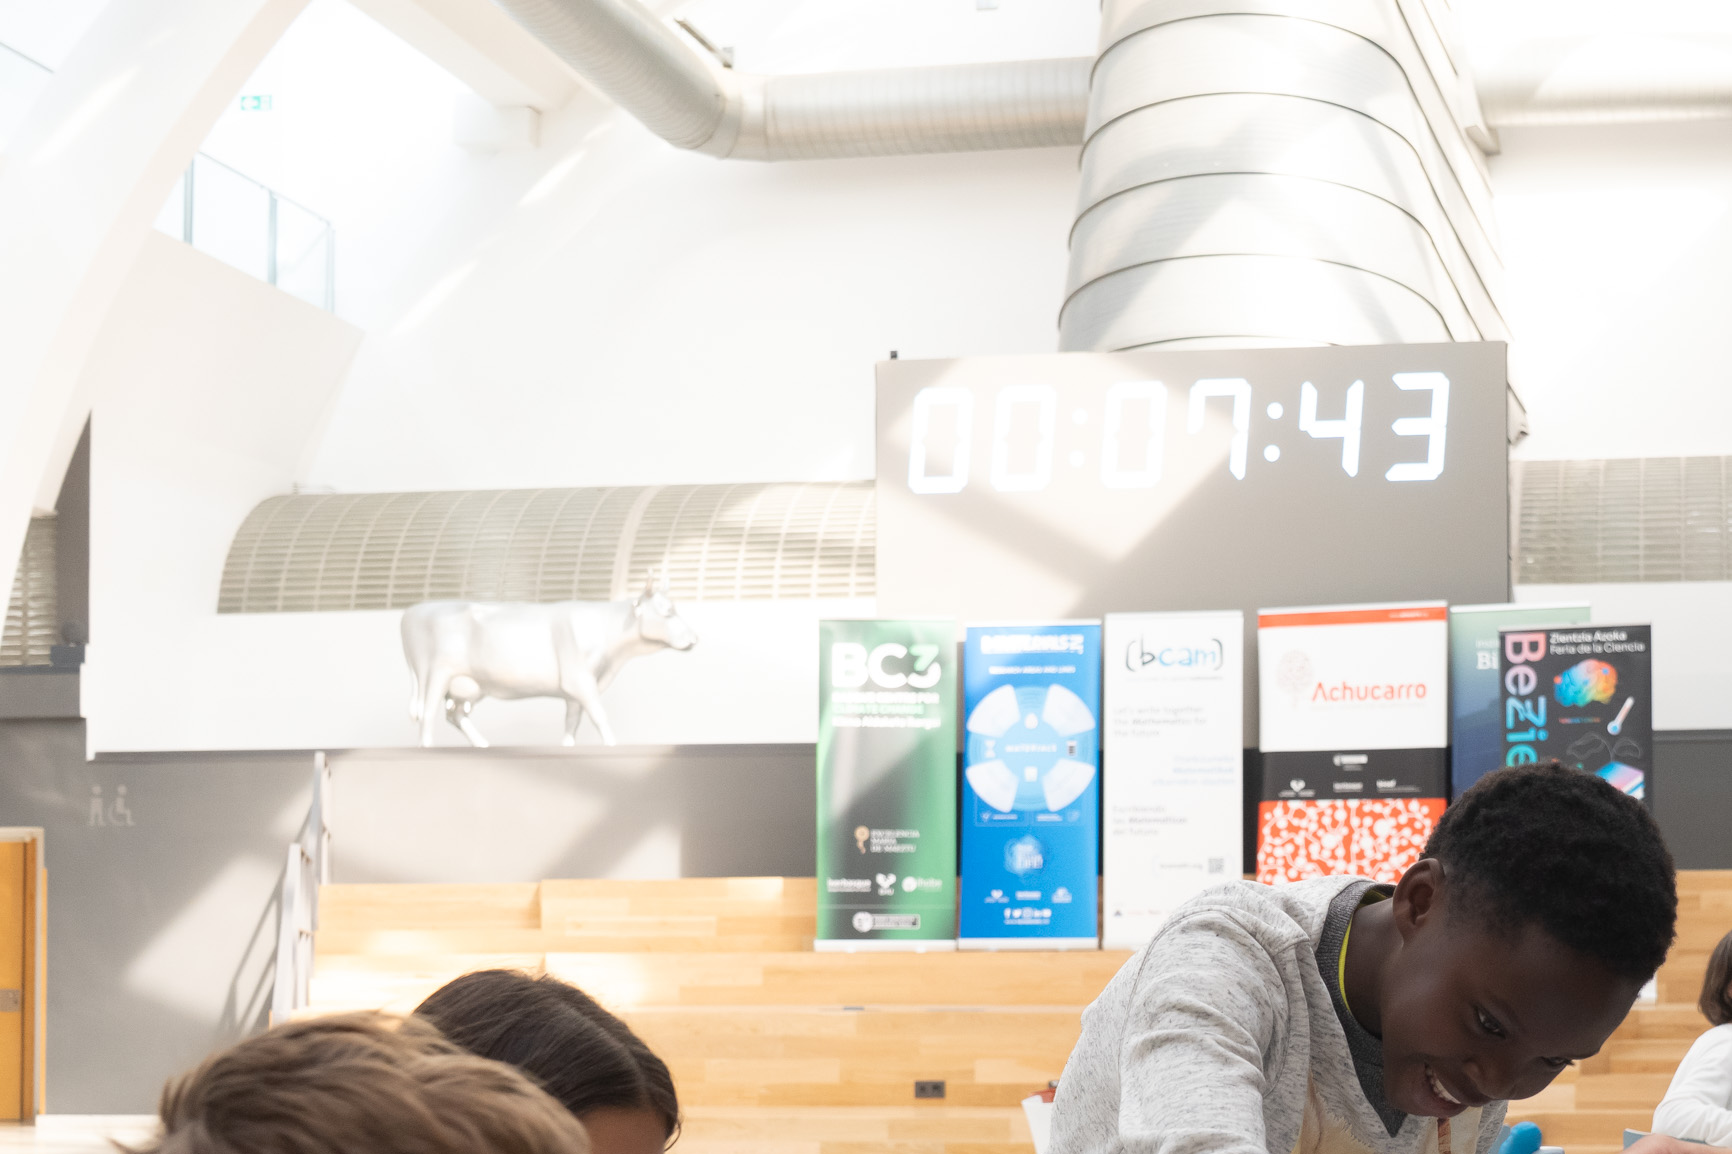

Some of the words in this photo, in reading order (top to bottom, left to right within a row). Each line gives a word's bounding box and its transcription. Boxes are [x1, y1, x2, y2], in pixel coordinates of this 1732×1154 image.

[907, 371, 1450, 494] 00:07:43
[1577, 643, 1592, 654] de
[1604, 640, 1646, 653] Ciencia
[831, 642, 941, 688] BC3
[1312, 681, 1428, 702] Achucarro
